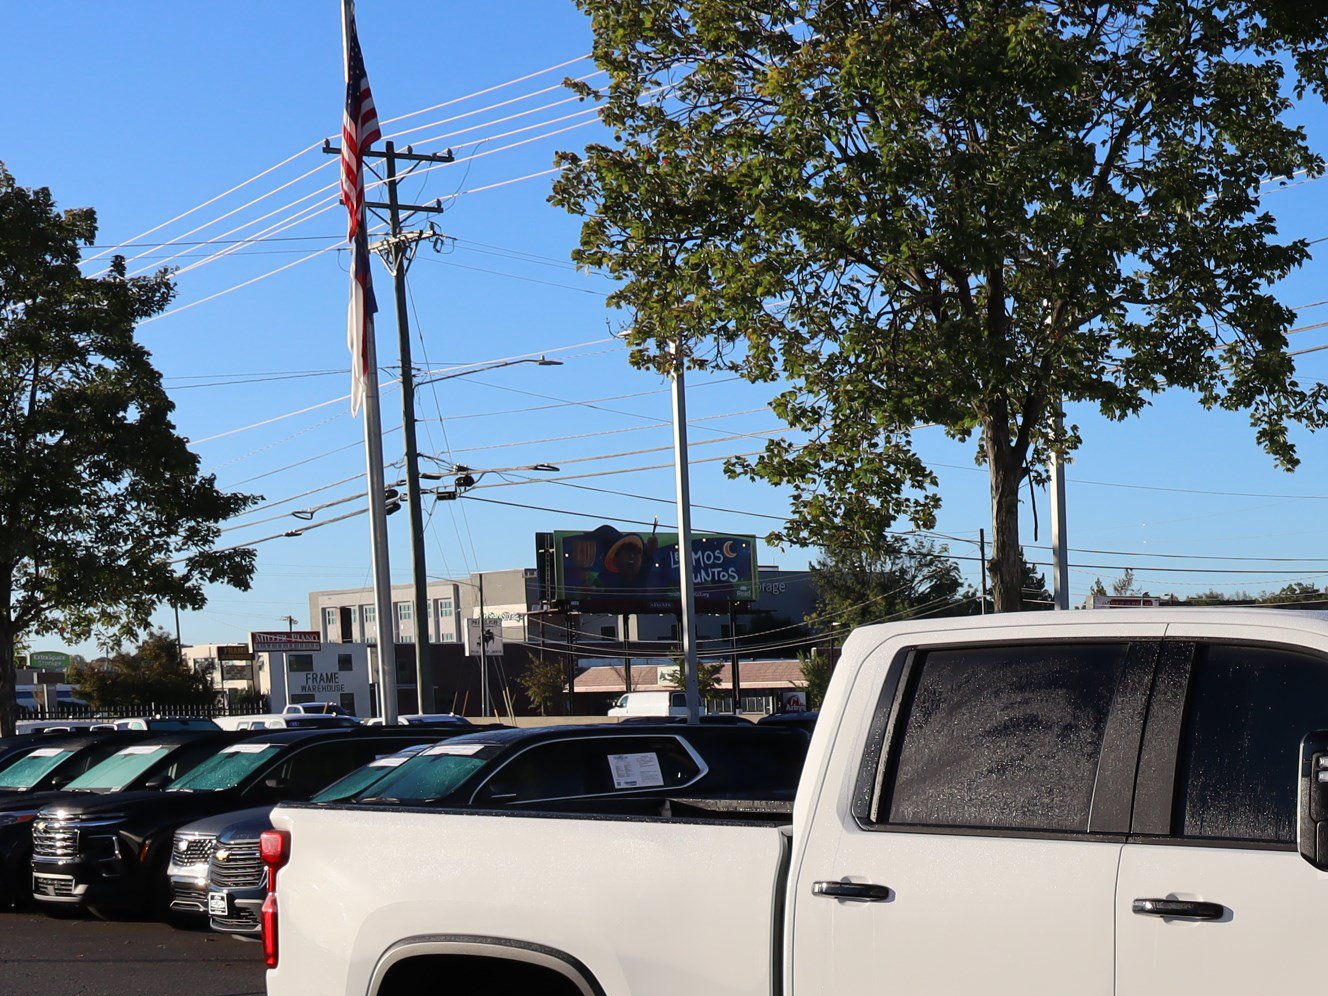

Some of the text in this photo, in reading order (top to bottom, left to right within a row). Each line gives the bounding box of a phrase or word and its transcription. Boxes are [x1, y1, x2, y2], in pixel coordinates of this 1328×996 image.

[670, 549, 724, 569] LEMOS
[692, 567, 739, 583] UNTOS
[255, 633, 319, 643] MILLER PIANO
[305, 672, 340, 684] FRAME
[301, 684, 345, 692] WAREHOUSE
